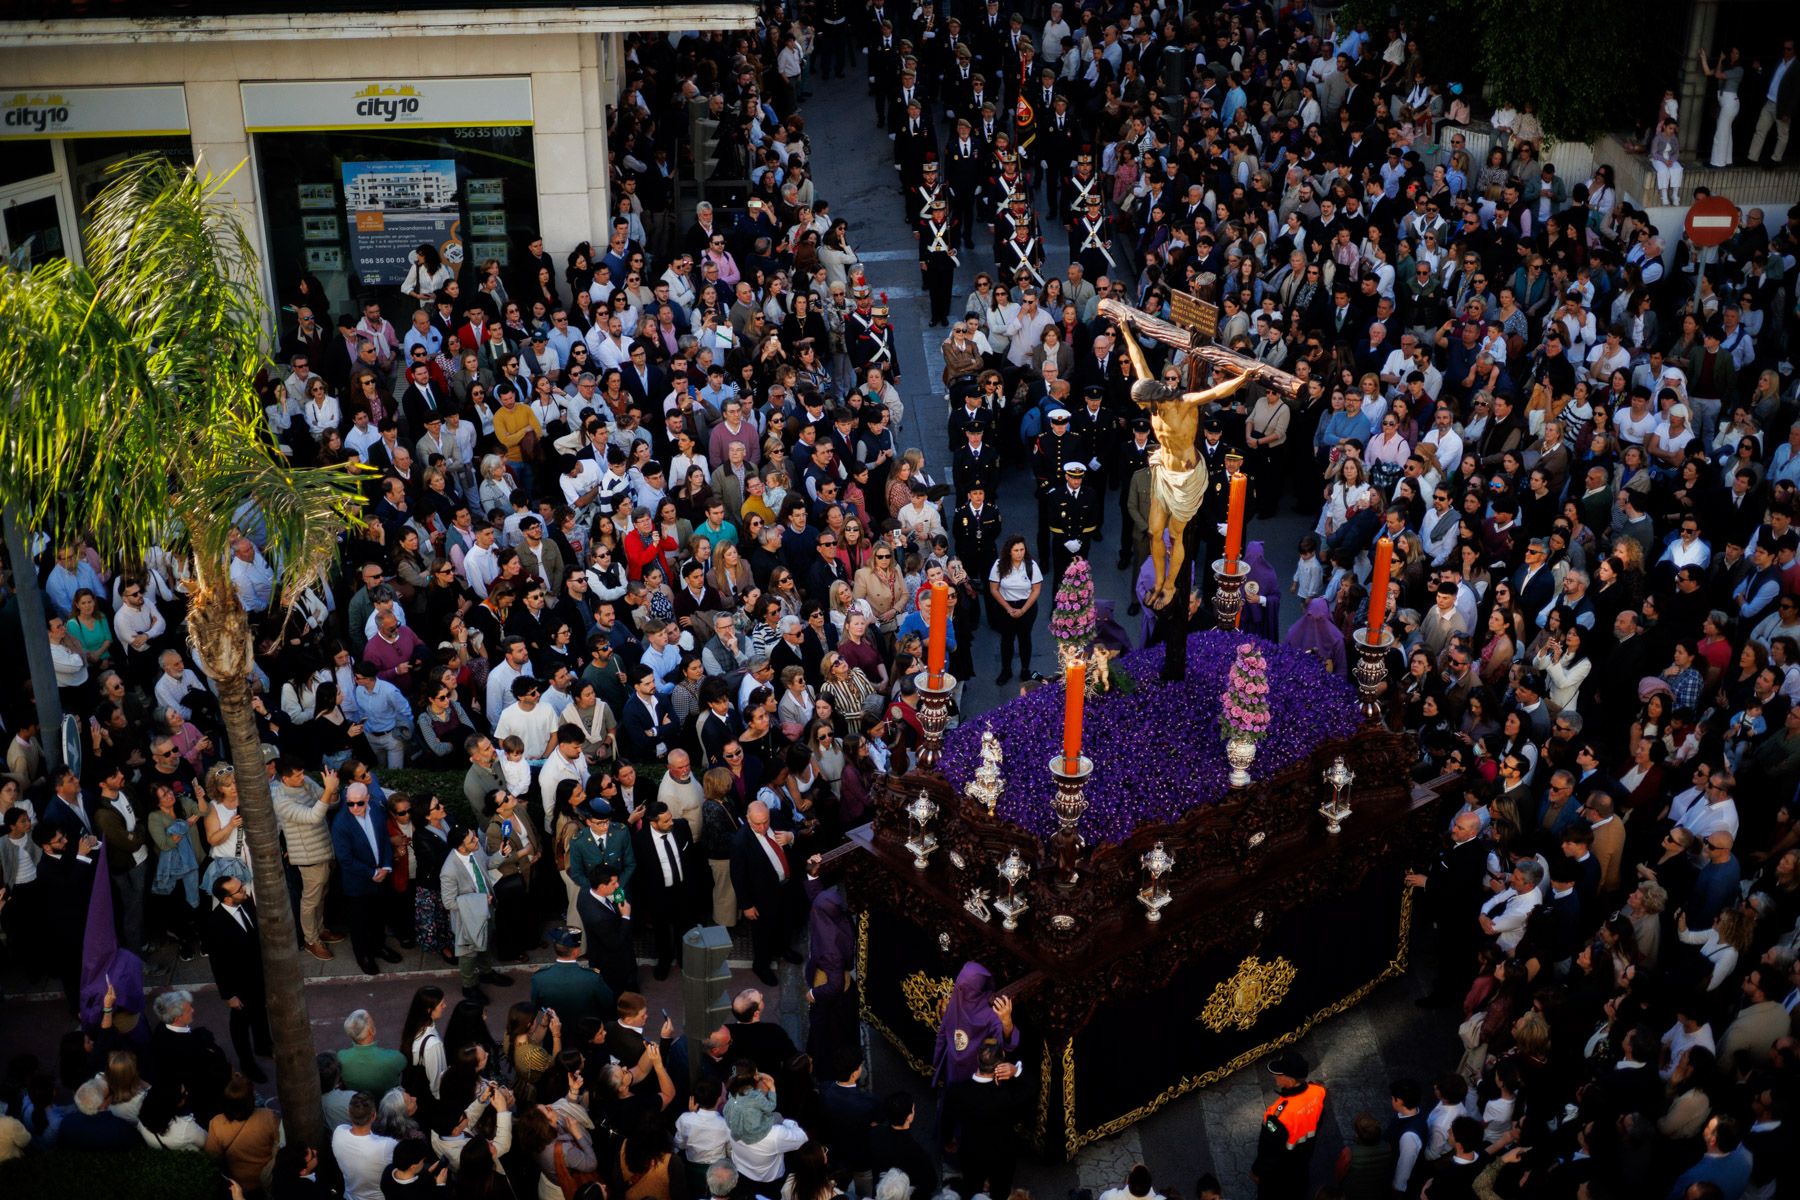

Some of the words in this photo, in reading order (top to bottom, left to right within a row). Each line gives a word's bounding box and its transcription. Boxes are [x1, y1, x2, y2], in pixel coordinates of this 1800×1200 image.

[5, 107, 69, 132] city10
[356, 97, 419, 122] city10
[454, 127, 476, 138] 956
[476, 127, 491, 138] 35
[492, 127, 507, 137] 00
[508, 126, 522, 137] 03
